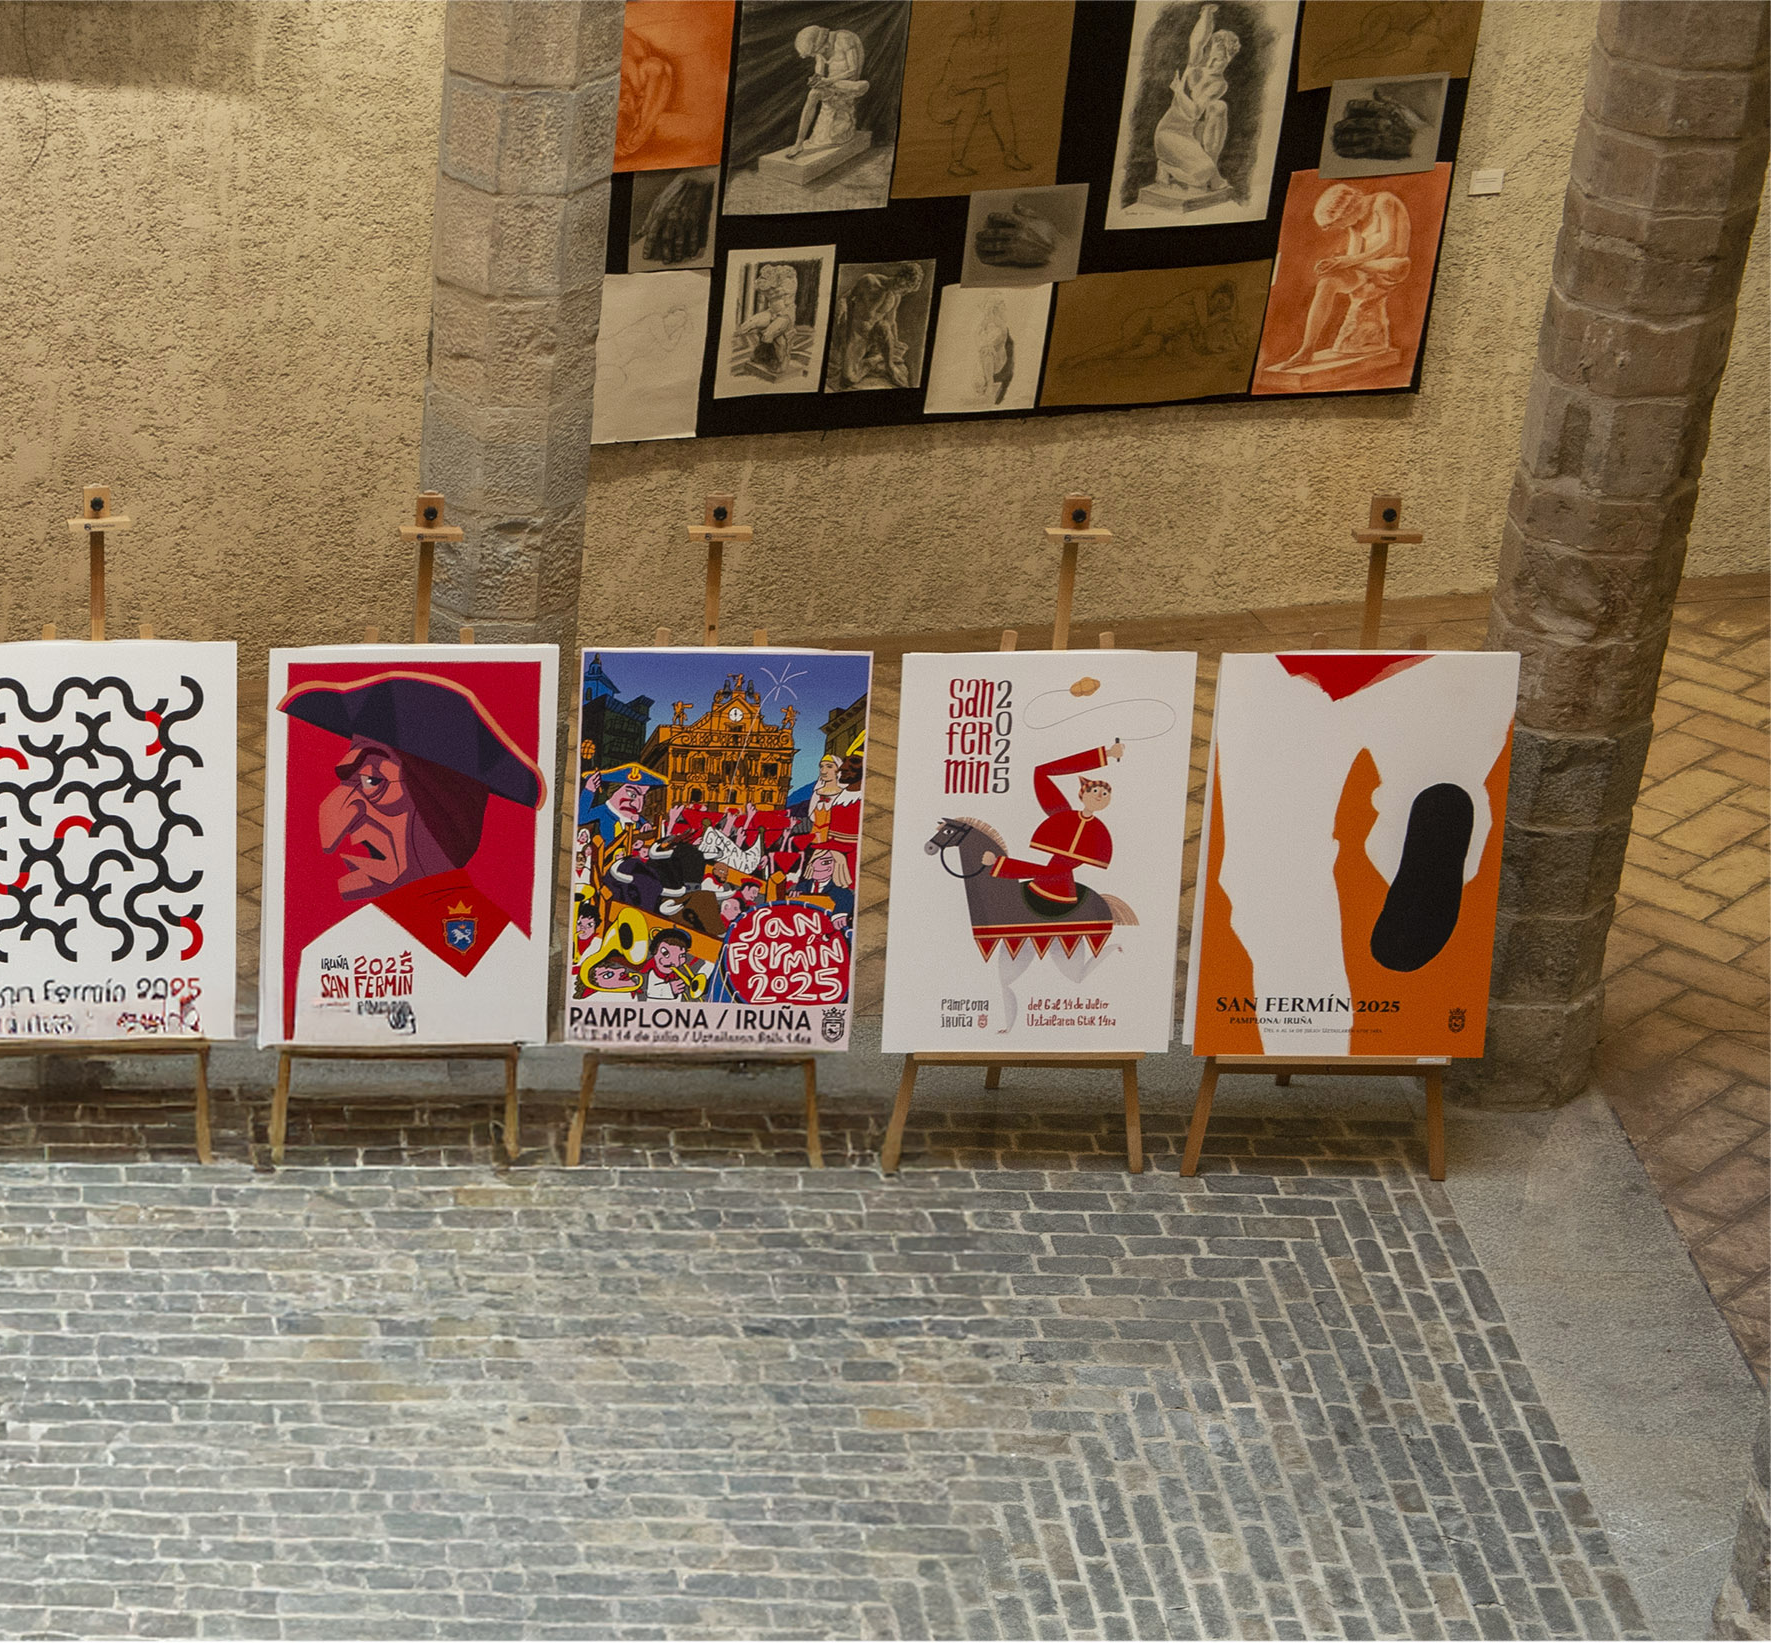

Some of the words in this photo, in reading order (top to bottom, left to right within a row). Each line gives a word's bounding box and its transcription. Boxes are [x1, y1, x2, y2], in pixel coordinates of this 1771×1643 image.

[354, 955, 414, 976] 2025
[321, 973, 349, 999] SAN
[354, 973, 413, 999] FERMIN
[747, 967, 843, 1003] 2025
[1028, 997, 1042, 1010] del
[1044, 999, 1050, 1010] 6
[1052, 999, 1060, 1010] al
[1063, 999, 1073, 1010] 14
[1074, 997, 1083, 1010] de
[1216, 996, 1258, 1013] SAN
[1265, 993, 1351, 1013] FERMÍN
[1357, 1000, 1401, 1013] 2025
[569, 1007, 708, 1028] PAMPLONA
[736, 1005, 812, 1030] IRUÑA
[1283, 1016, 1313, 1025] IRUÑA
